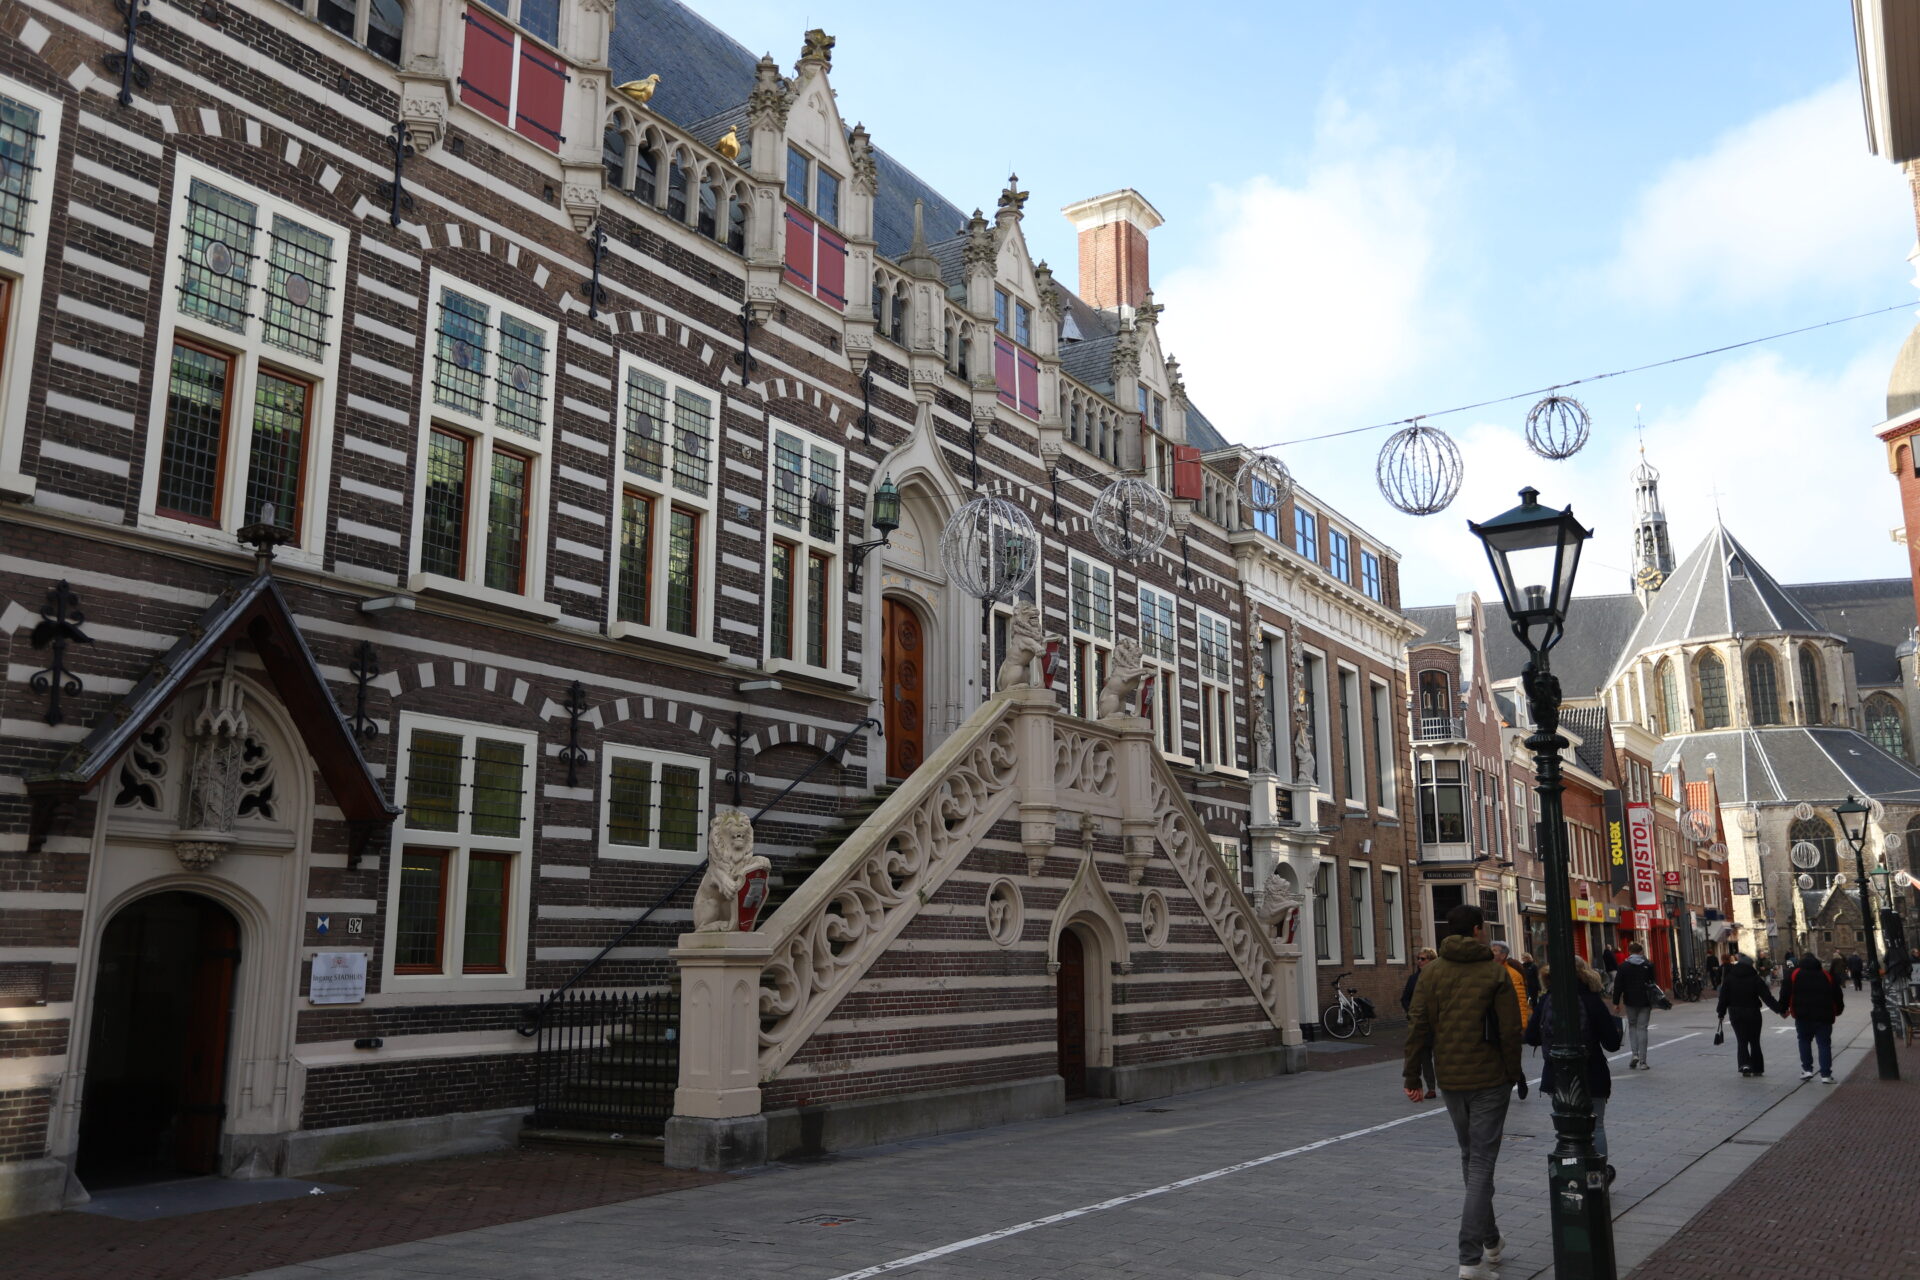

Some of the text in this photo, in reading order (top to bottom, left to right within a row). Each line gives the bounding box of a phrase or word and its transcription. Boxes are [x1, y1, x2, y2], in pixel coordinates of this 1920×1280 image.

[1609, 821, 1624, 866] xenos
[1632, 818, 1652, 893] BRISTOL
[349, 919, 361, 932] 97
